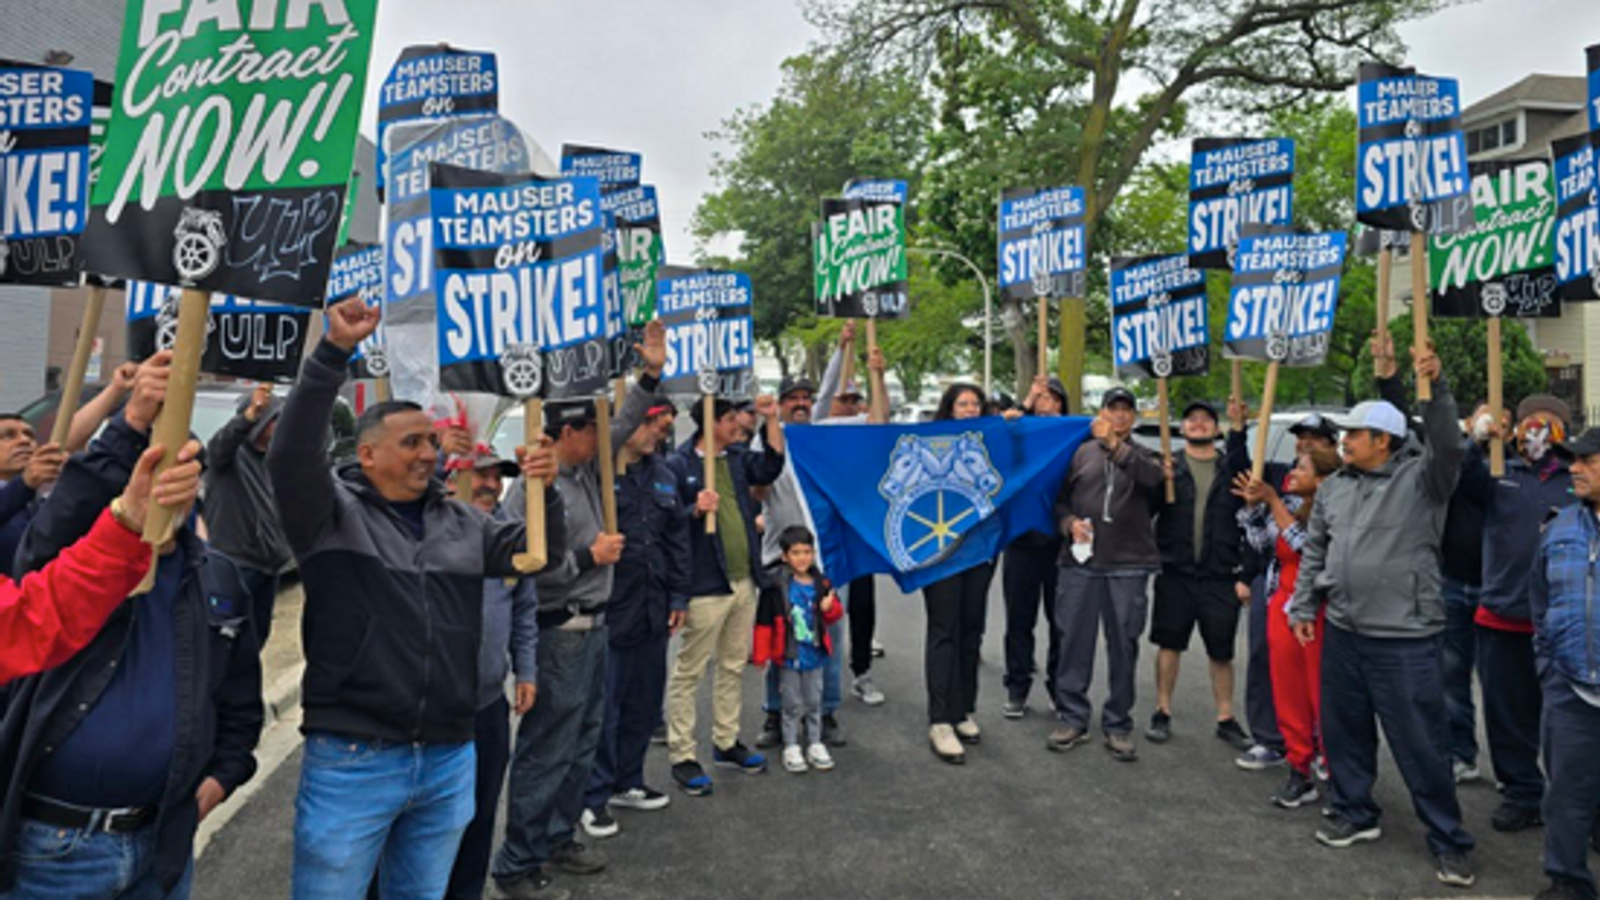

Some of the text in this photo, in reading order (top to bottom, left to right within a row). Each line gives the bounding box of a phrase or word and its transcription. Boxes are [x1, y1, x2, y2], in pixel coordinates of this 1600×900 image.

[0, 72, 63, 95] SER
[122, 22, 359, 118] Contract
[395, 55, 481, 80] MAUSER
[384, 71, 495, 104] TEAMSTERS
[421, 96, 455, 116] on
[105, 73, 353, 225] NOW!
[1205, 140, 1279, 164] MAUSER
[1194, 153, 1289, 185] TEAMSTERS
[1362, 135, 1464, 209] STRKE!
[1470, 161, 1550, 209] AIR
[454, 182, 574, 215] MAUSER
[1003, 198, 1081, 230] TEAMSTERS
[438, 199, 594, 246] TEAMSTERS
[828, 204, 897, 243] FAIR
[331, 248, 383, 272] MAUS
[494, 240, 542, 270] on
[1002, 228, 1082, 284] STRIKE!
[1240, 245, 1341, 271] TEAMSTERS
[1252, 234, 1331, 252] MAUSER
[1438, 216, 1555, 297] NOW!
[670, 274, 737, 293] MAUSER
[835, 245, 902, 303] NOW!
[1115, 268, 1202, 303] TEAMSTERS
[443, 253, 597, 359] STRIKE!
[661, 287, 749, 313] TEAMSTERS
[1230, 279, 1335, 339] STRIKE!
[219, 313, 299, 360] ULP
[1117, 297, 1205, 363] STRIKE!
[664, 319, 749, 377] STRIKE!
